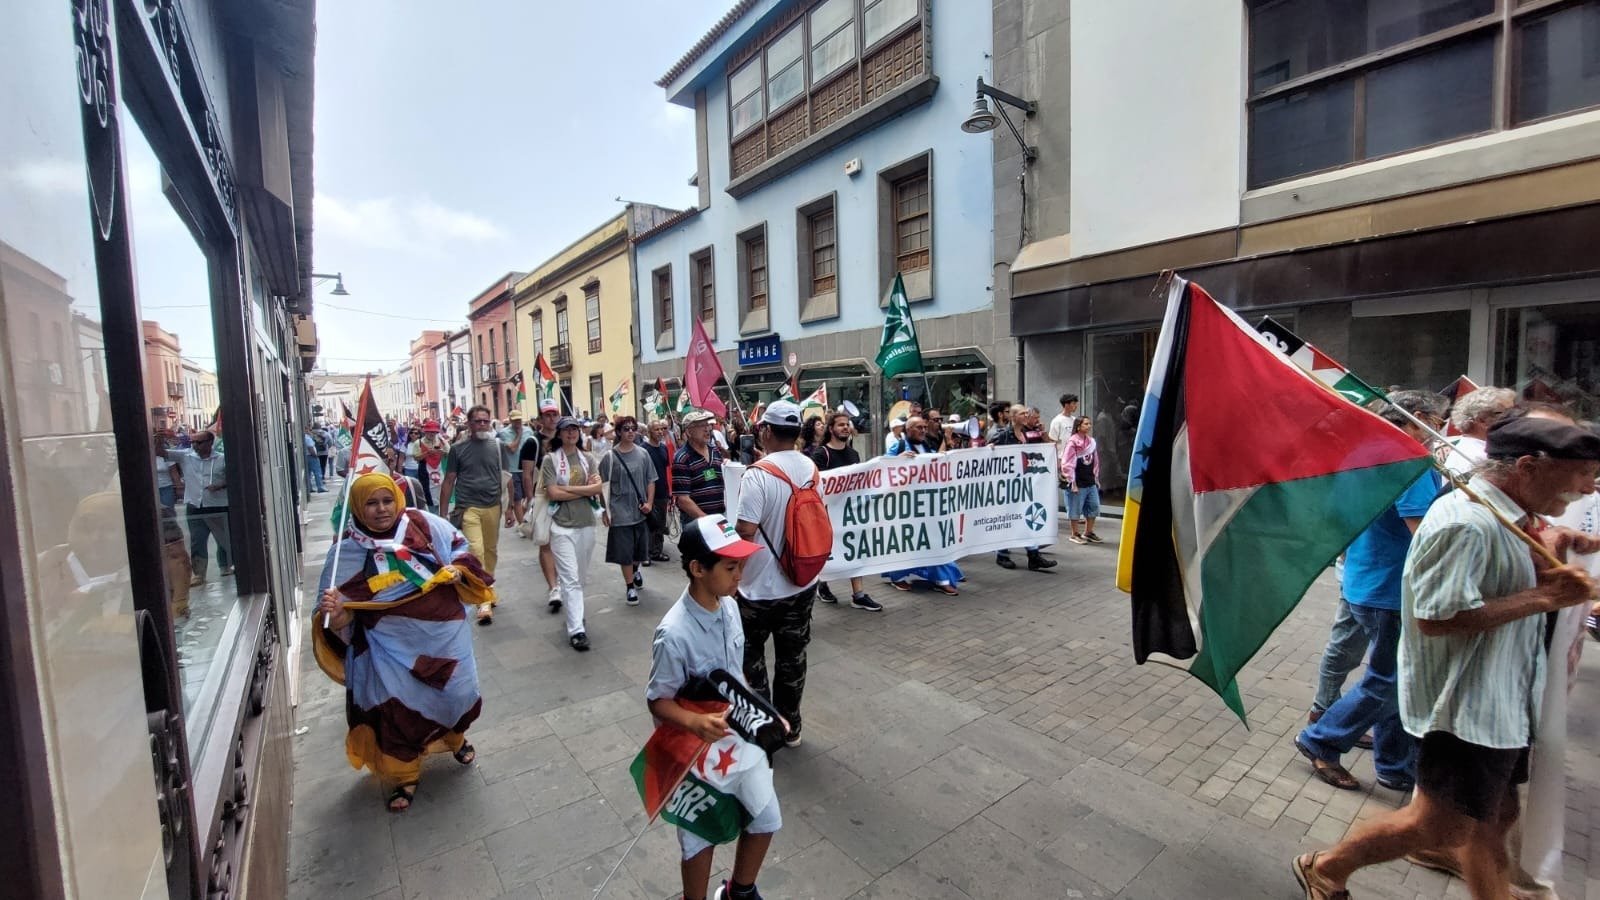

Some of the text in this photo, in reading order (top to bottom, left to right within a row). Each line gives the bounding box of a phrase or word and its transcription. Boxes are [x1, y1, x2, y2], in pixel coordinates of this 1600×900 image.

[887, 458, 953, 488] ESPAÑOL
[956, 455, 1016, 480] GARANTICE
[842, 473, 1034, 527] AUTODETERMINACIÓN
[973, 512, 1023, 527] anticapitalistas
[985, 521, 1012, 533] canarias
[842, 522, 931, 562] SAHARA
[665, 779, 718, 823] BRE
